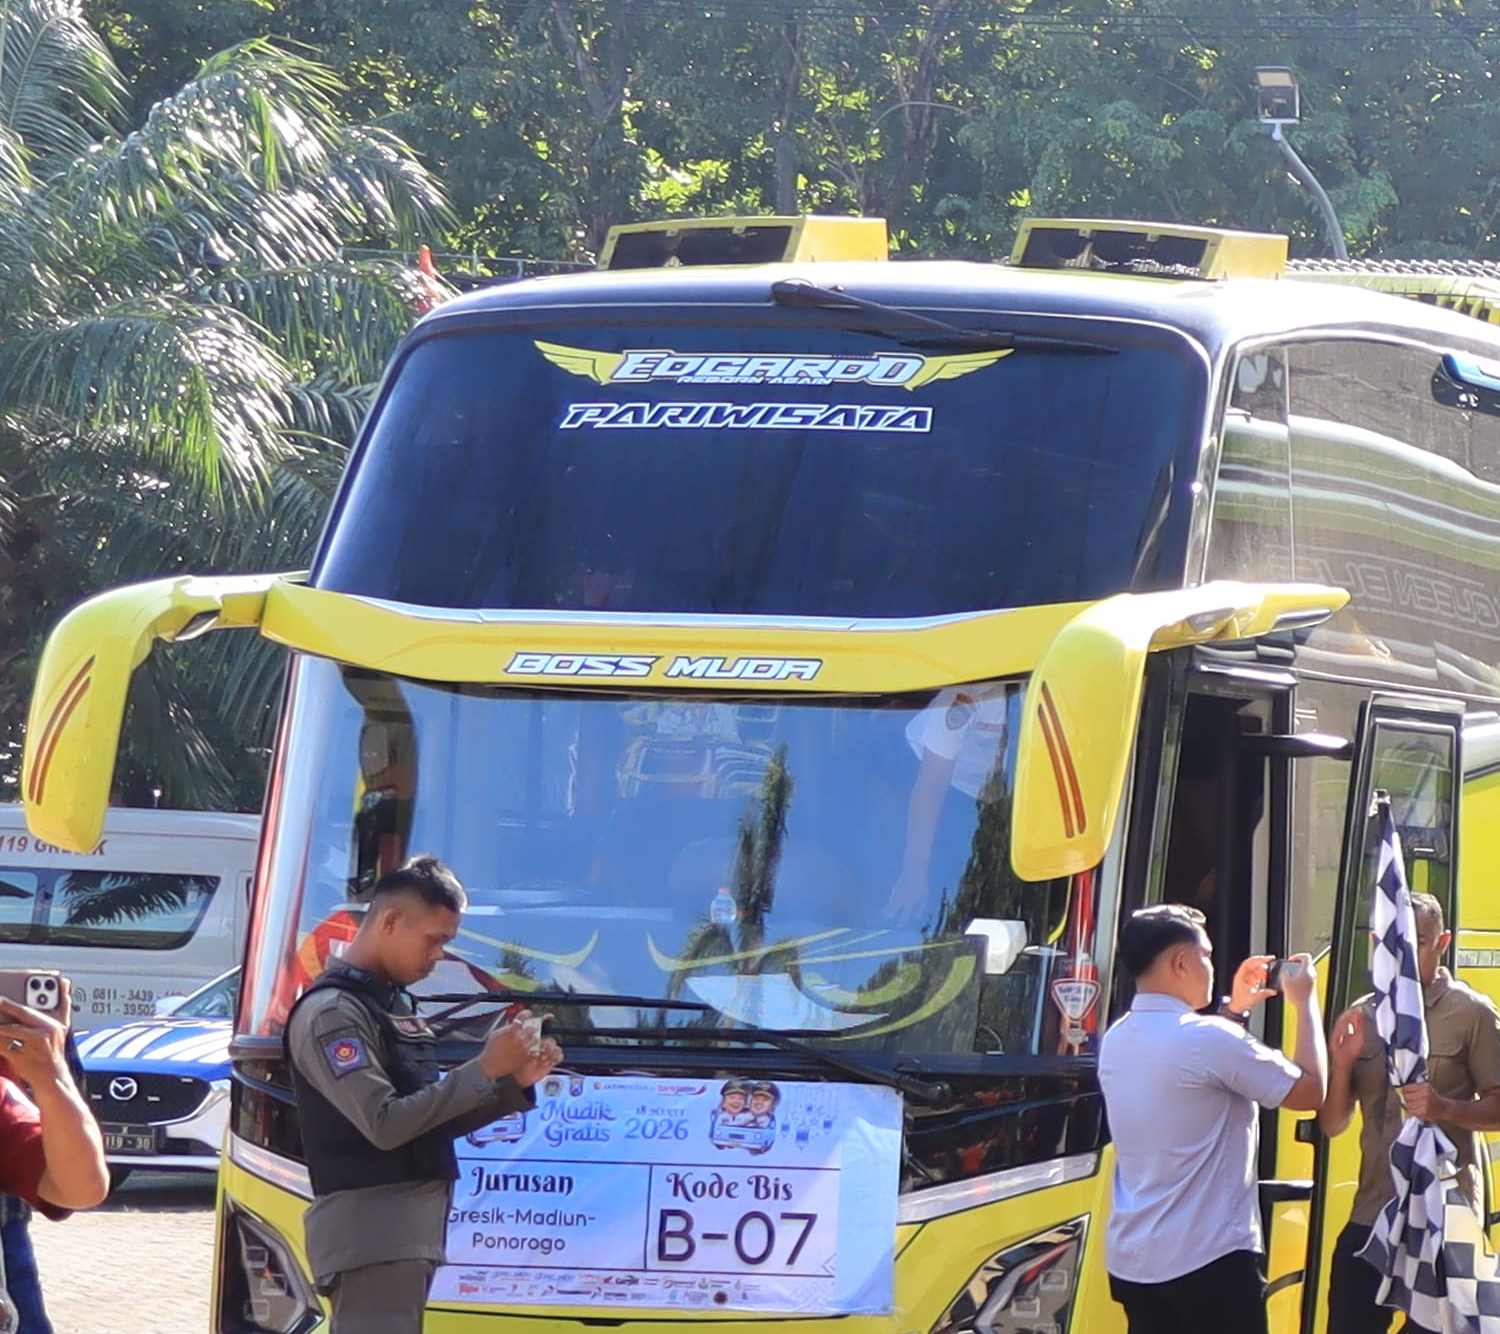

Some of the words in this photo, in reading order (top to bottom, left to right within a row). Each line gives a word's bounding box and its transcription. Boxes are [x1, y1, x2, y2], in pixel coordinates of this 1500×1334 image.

[677, 376, 763, 385] REBORN
[560, 402, 933, 433] PARIWISATA
[504, 653, 662, 677] BOSS
[664, 657, 823, 680] MUDA
[540, 1099, 617, 1124] Mudik
[544, 1122, 612, 1147] Gratis
[623, 1118, 691, 1141] 2026
[470, 1166, 574, 1197] Jurusan
[666, 1171, 739, 1202] Kode
[746, 1173, 793, 1201] Bis
[472, 1232, 566, 1253] Ponorogo
[657, 1208, 819, 1266] B-07
